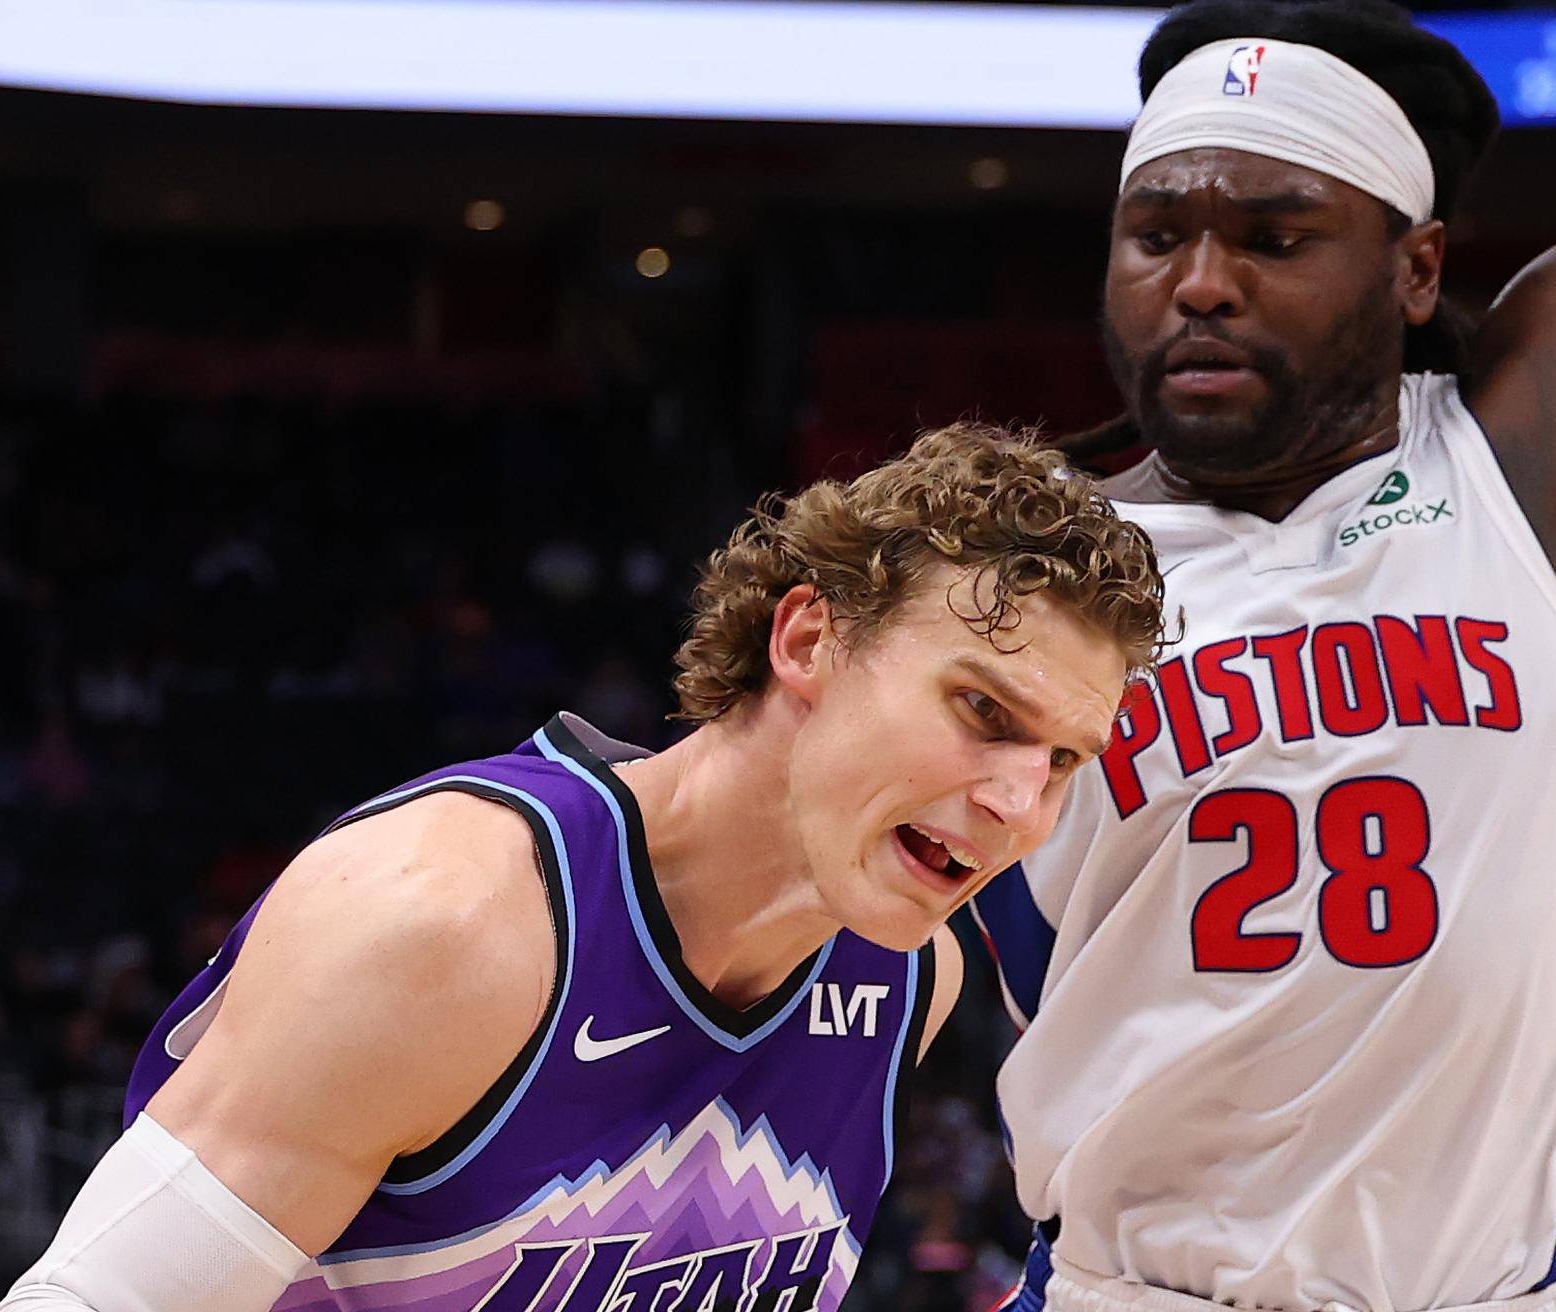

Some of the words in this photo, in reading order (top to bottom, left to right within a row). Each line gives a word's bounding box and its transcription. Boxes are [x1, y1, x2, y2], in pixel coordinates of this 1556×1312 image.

[1099, 615, 1522, 821] PISTONS
[1189, 775, 1439, 972] 28
[808, 983, 890, 1037] LVT
